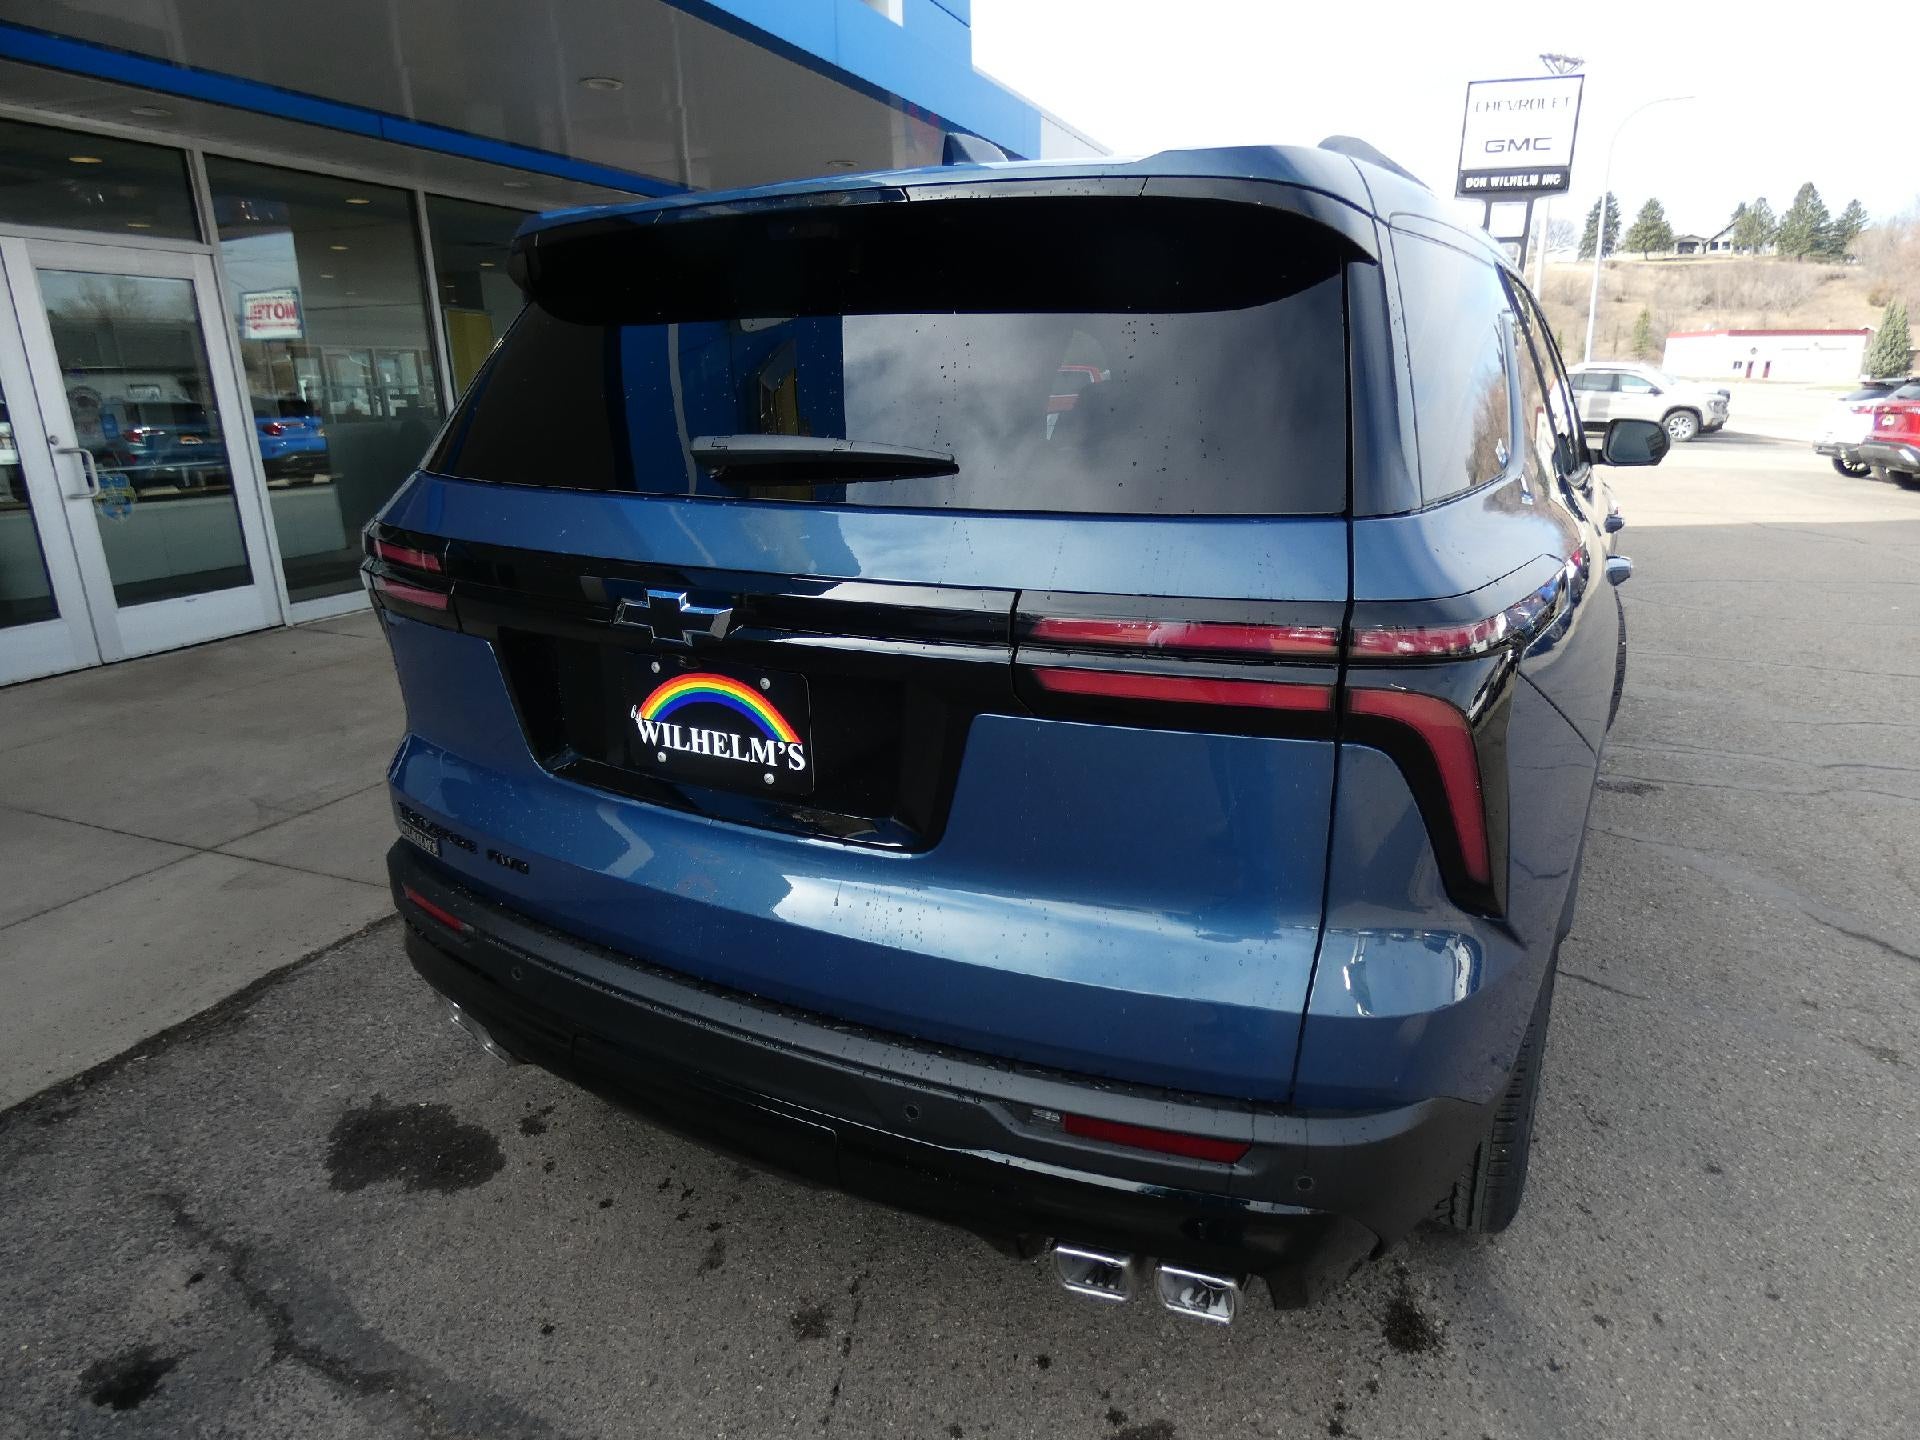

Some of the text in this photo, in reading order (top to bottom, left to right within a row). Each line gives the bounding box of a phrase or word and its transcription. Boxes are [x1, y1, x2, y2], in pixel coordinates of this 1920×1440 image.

[1485, 137, 1552, 153] GMC
[1465, 177, 1488, 188] DON
[1490, 174, 1539, 188] WILHELM
[636, 717, 807, 771] WILHELM'S
